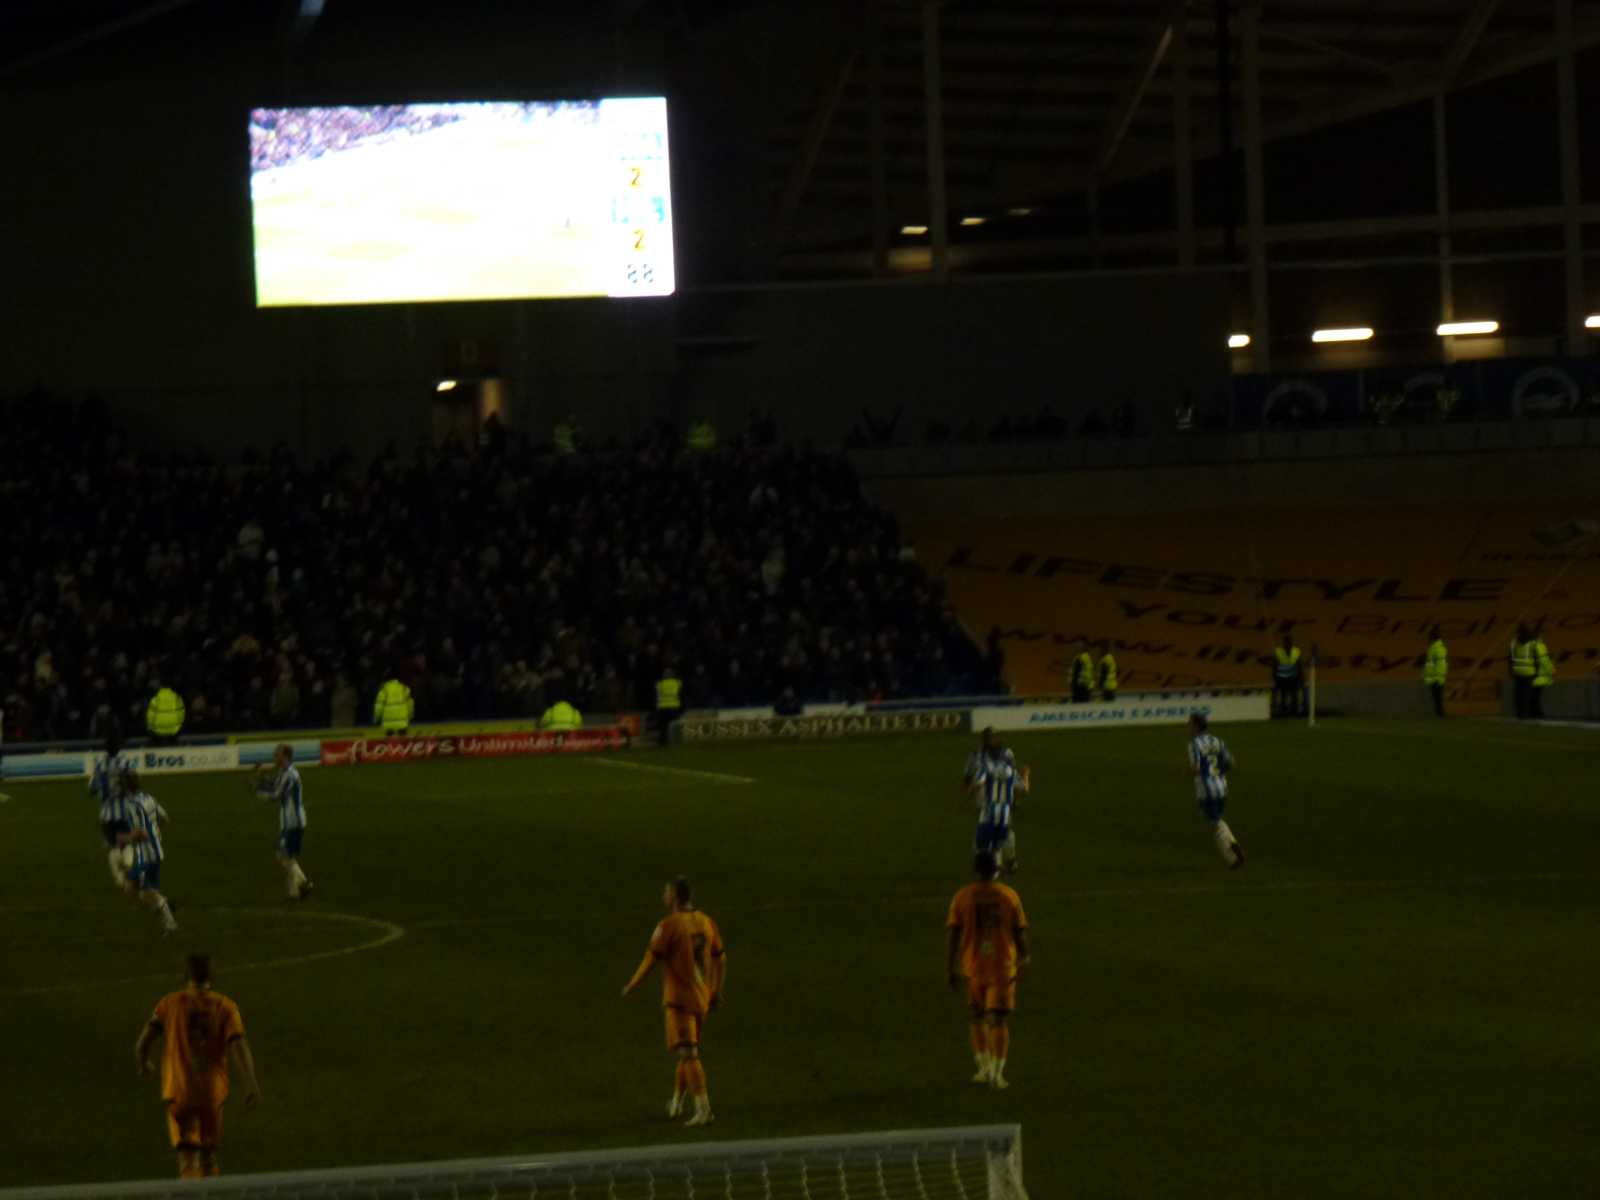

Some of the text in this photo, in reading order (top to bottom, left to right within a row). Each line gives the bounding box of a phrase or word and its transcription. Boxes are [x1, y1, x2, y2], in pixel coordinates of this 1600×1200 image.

[629, 166, 642, 187] 2
[632, 229, 645, 251] 2
[946, 547, 1509, 601] LIFESTYLE
[681, 711, 963, 738] SUSSEX ASPHALTE LTD
[1029, 705, 1211, 723] AMERICAN EXPRESS
